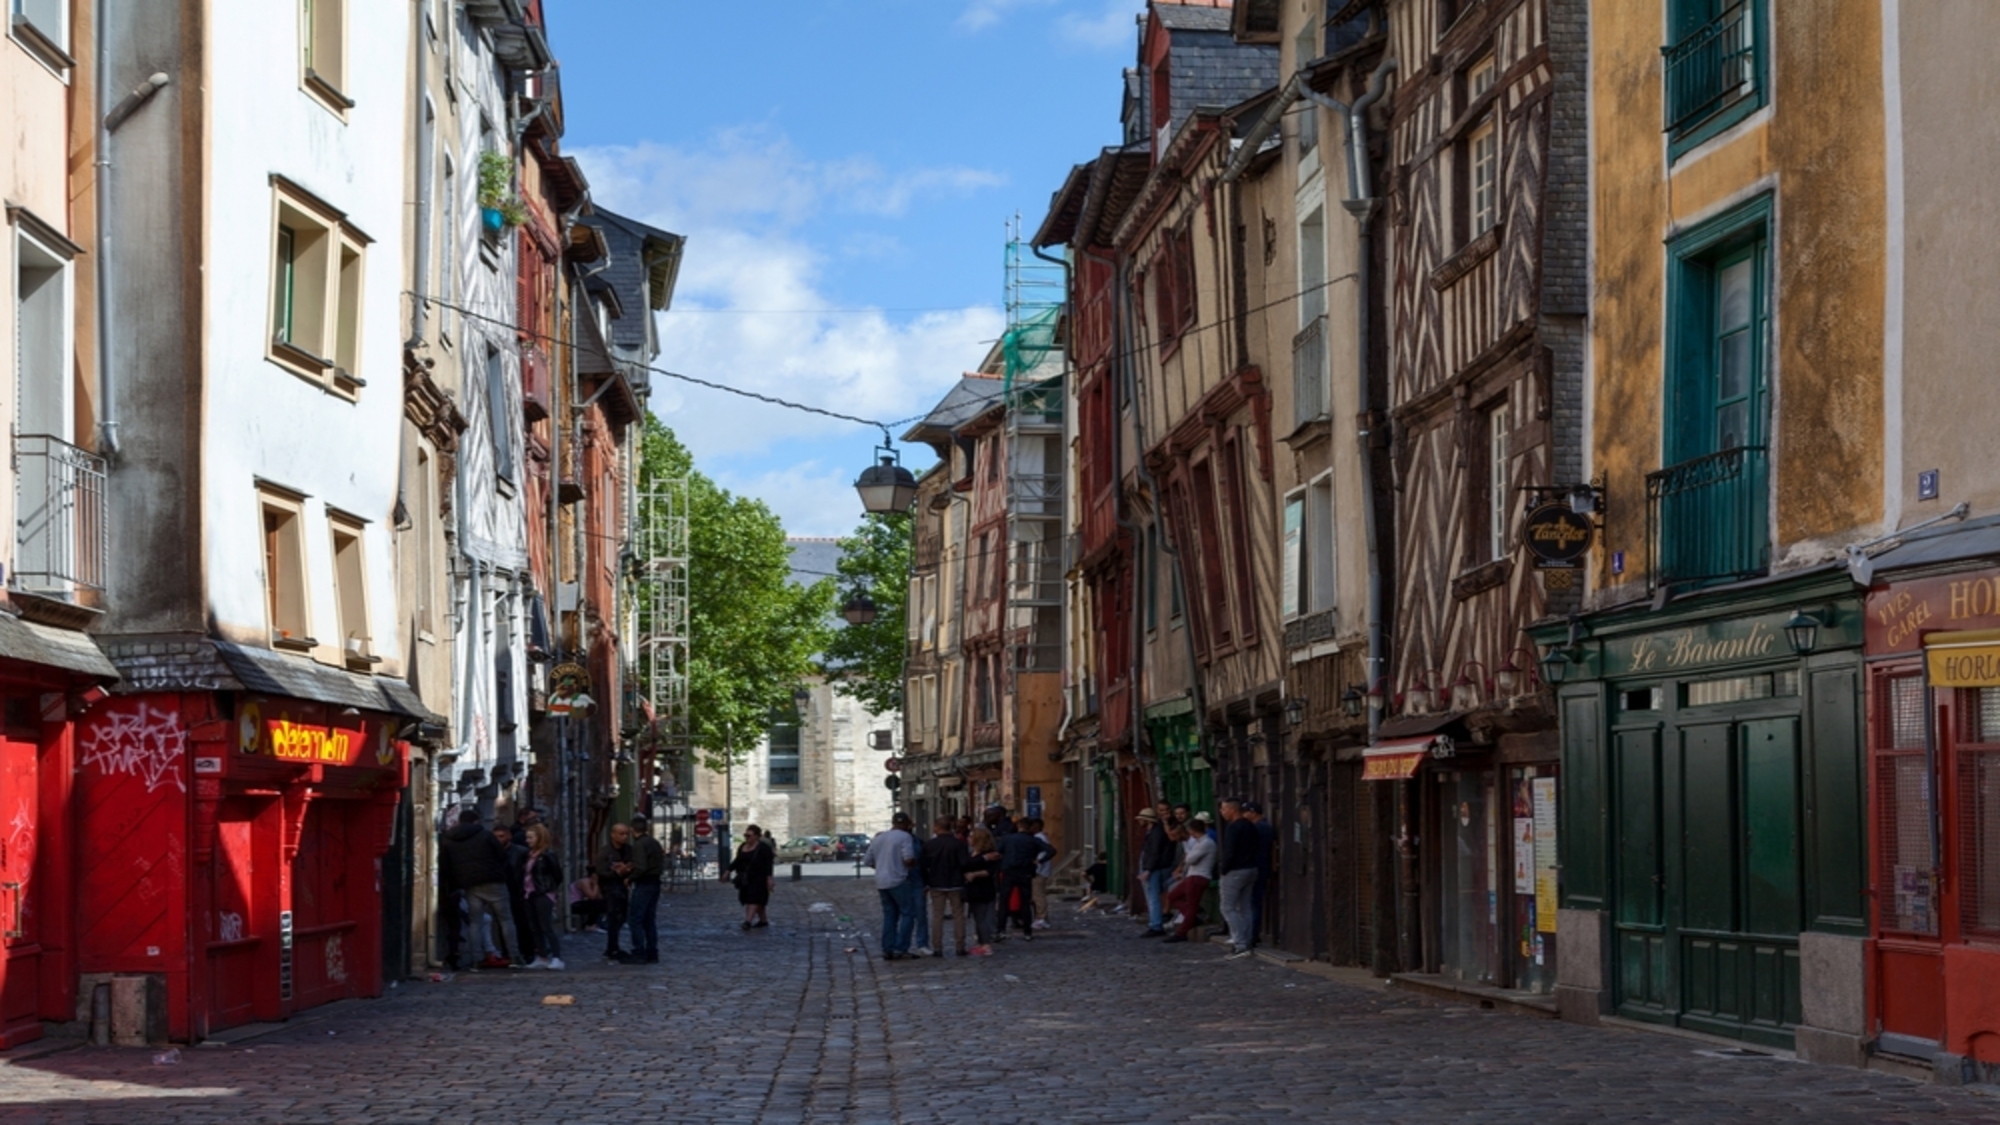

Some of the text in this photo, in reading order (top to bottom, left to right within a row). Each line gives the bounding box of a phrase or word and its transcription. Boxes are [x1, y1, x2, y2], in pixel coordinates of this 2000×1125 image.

[1922, 475, 1932, 496] 2
[1878, 586, 1912, 626] YVES
[1887, 600, 1932, 647] GAREL
[1628, 637, 1657, 671] Le
